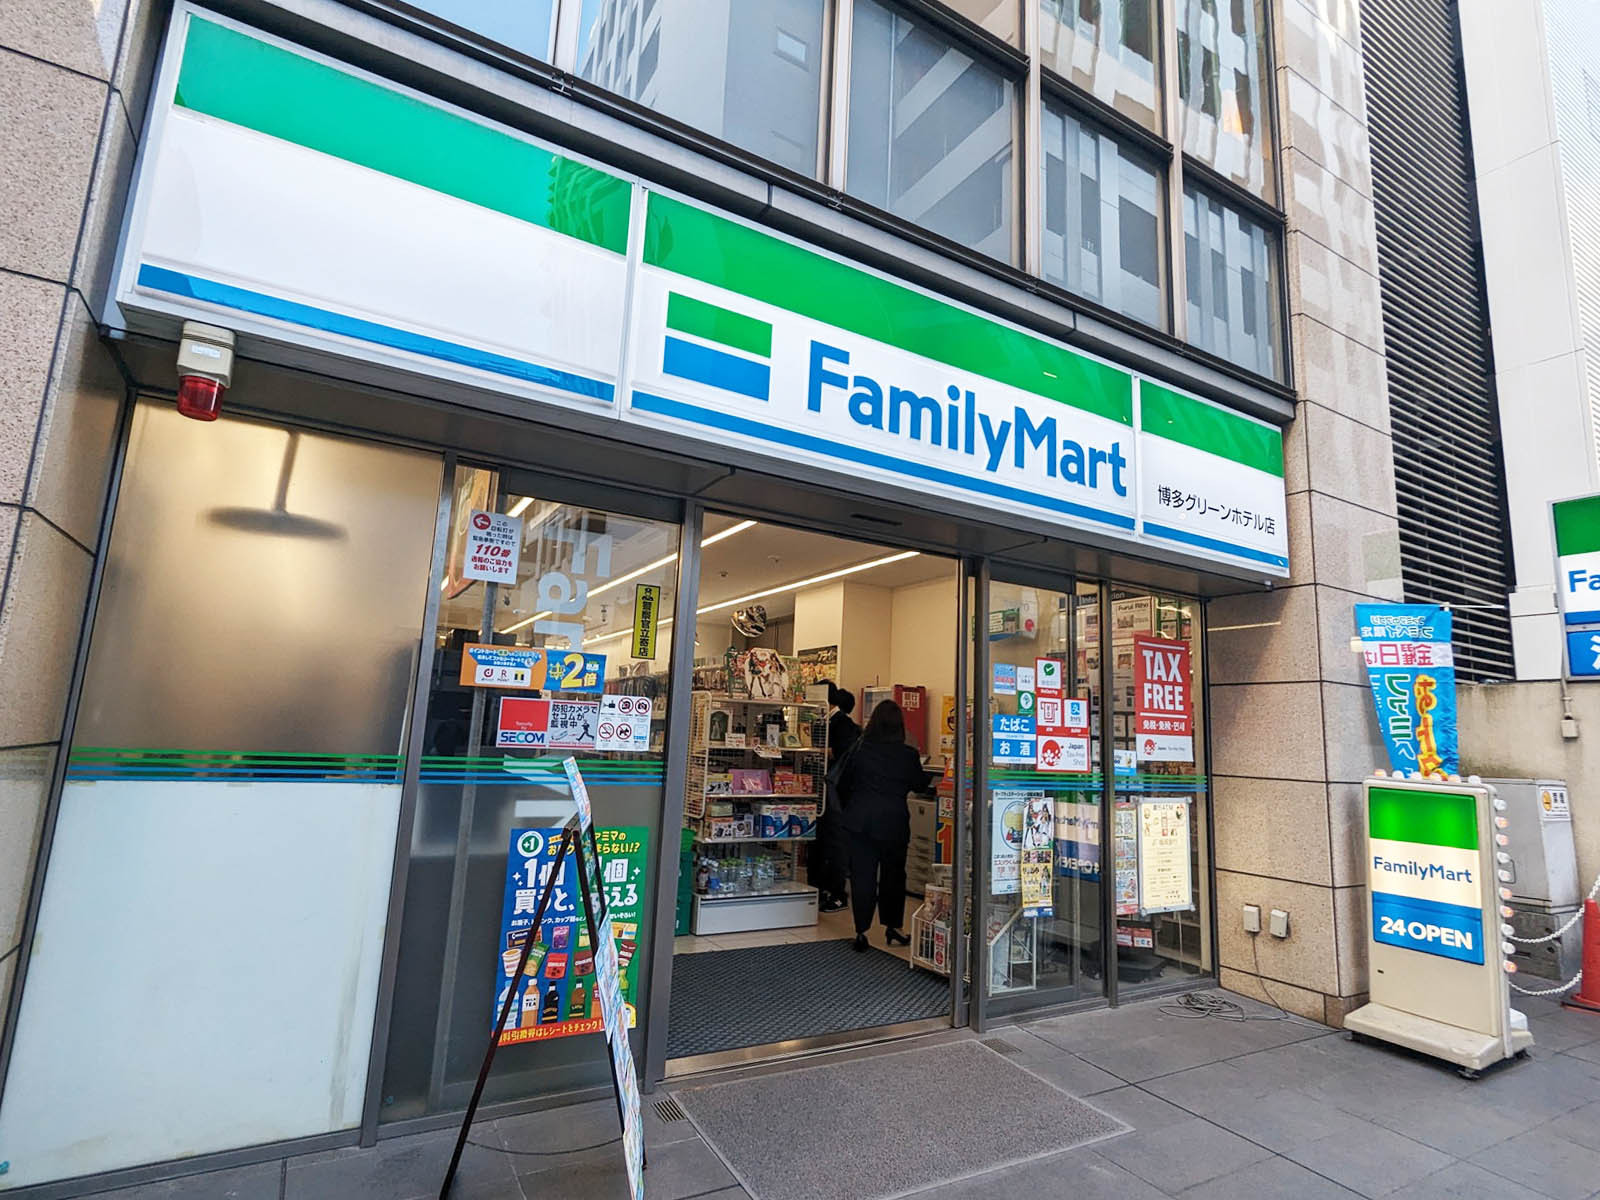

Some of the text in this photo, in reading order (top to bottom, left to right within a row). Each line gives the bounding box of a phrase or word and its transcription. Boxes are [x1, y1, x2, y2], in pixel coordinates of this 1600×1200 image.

[807, 339, 1127, 497] FamilyMart
[1157, 484, 1276, 535] 博多グリーンホテル店
[475, 543, 512, 558] 110番
[561, 653, 584, 688] 2
[1142, 649, 1183, 682] TAX
[584, 673, 597, 687] 倍
[1143, 682, 1184, 711] FREE
[552, 704, 598, 714] 防犯カメラで
[552, 712, 585, 721] セコムが
[550, 720, 578, 728] 監視中
[1000, 717, 1030, 731] たばこ
[499, 731, 545, 743] SECOM
[595, 831, 626, 842] ァミマの
[1373, 856, 1472, 883] FamilyMart
